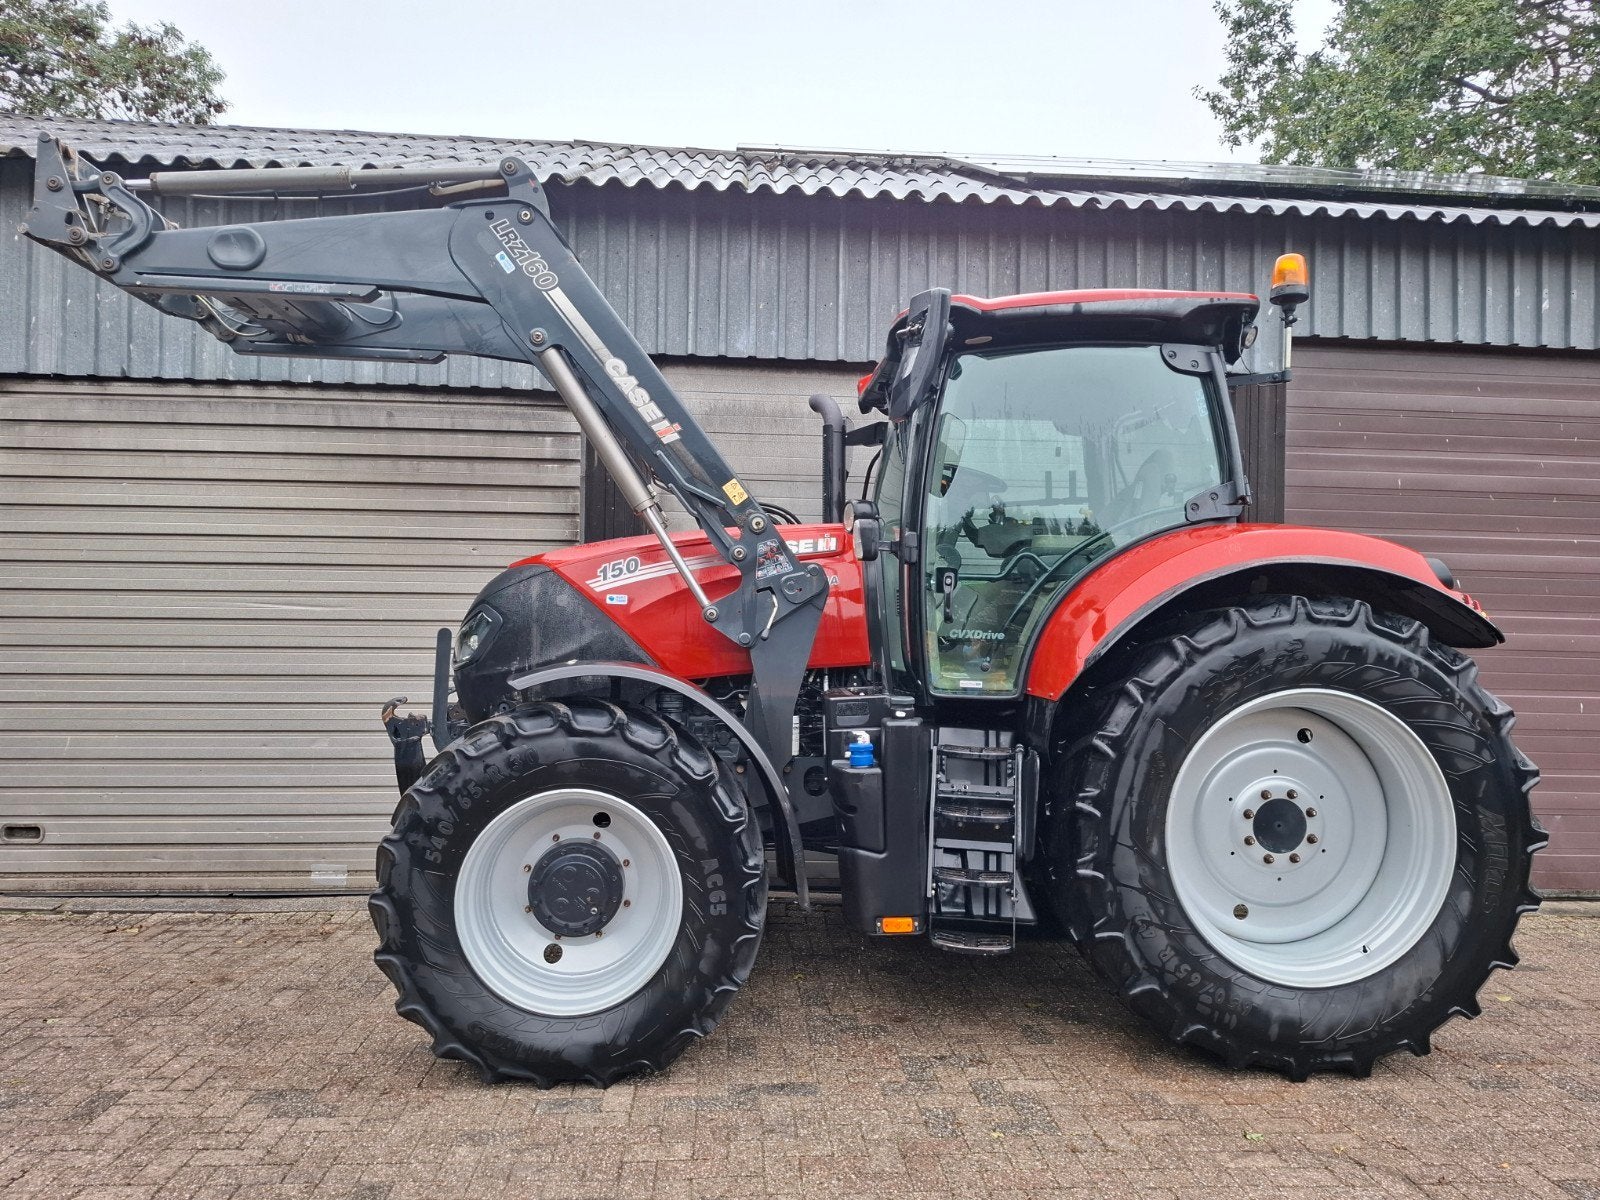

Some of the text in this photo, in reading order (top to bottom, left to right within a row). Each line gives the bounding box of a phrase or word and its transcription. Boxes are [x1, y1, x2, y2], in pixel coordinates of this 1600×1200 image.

[489, 218, 559, 290] LRZ160
[605, 357, 666, 423] CASE
[597, 556, 641, 582] 150
[949, 629, 1006, 641] CVXDrive
